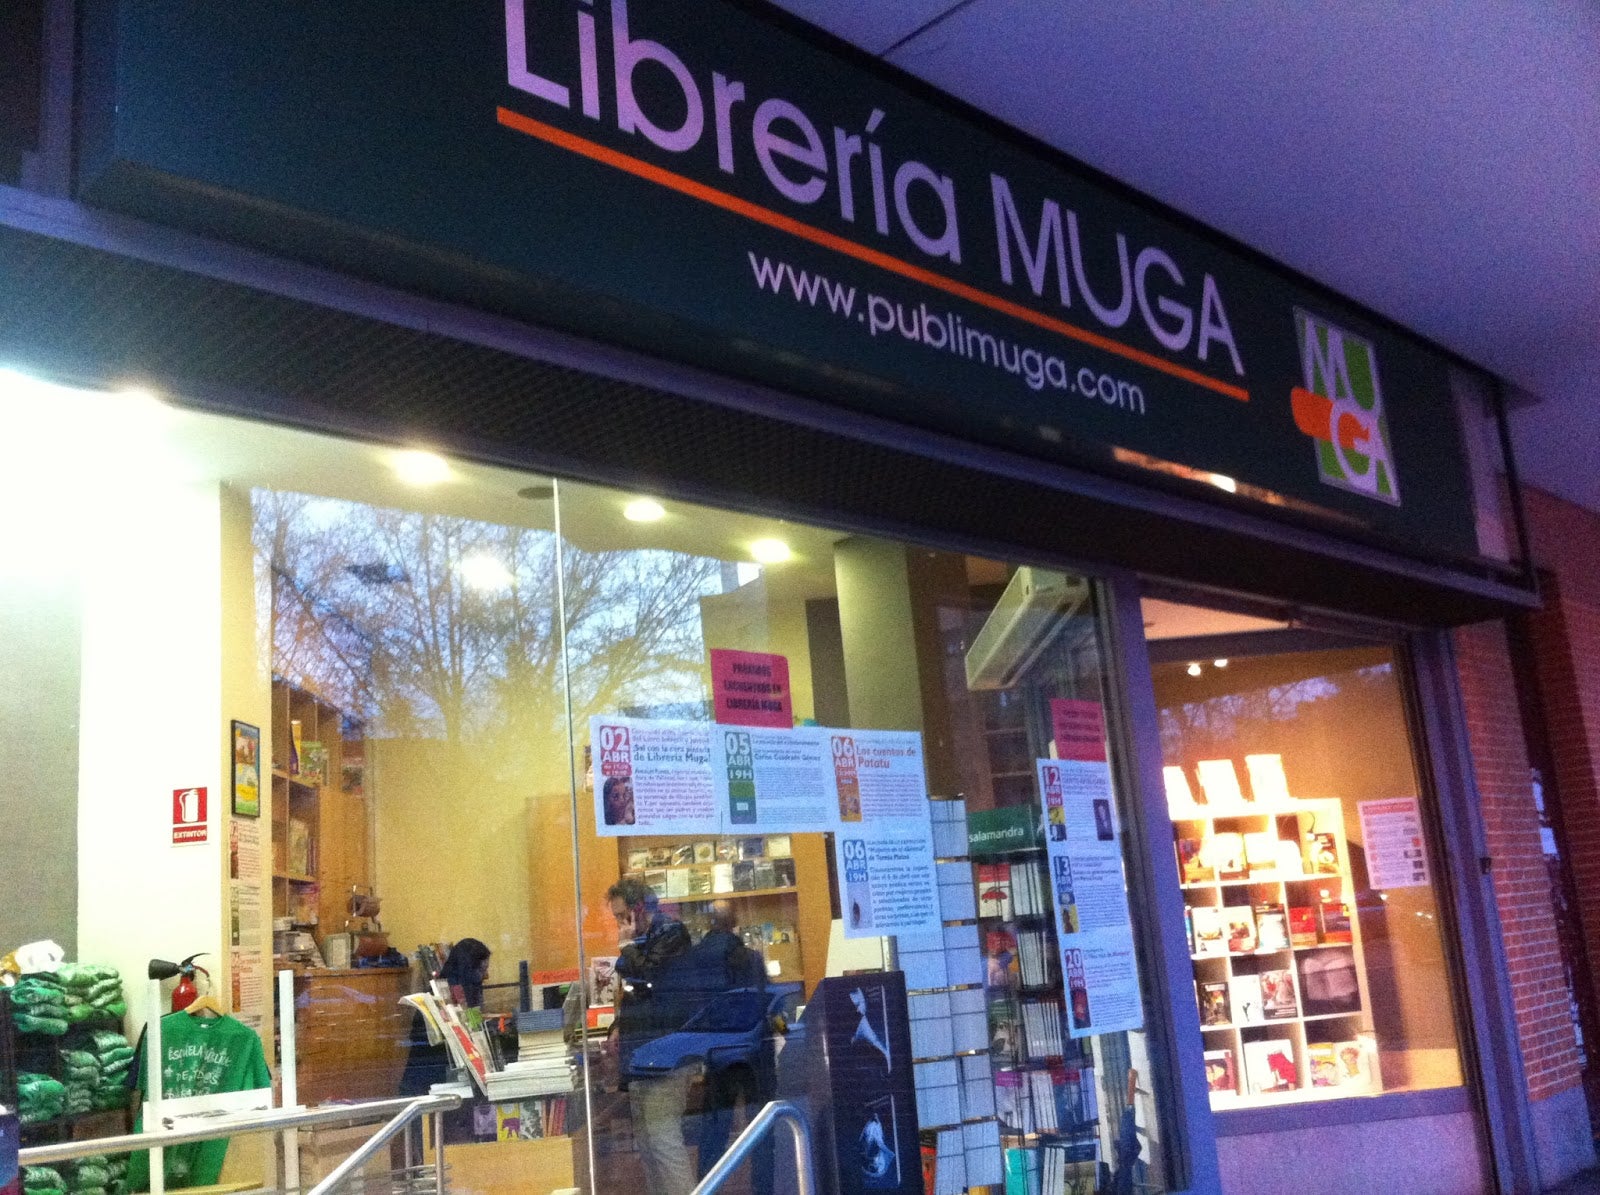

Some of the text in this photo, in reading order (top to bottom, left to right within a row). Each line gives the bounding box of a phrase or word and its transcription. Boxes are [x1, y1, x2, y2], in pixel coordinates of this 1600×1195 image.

[504, 0, 1245, 376] Librería MUGA
[748, 250, 1145, 415] www.publimuga.com
[600, 727, 629, 751] 02
[726, 732, 751, 755] 05
[832, 738, 855, 758] 06
[856, 745, 917, 757] Los cuentos de
[602, 751, 629, 763] ABR
[634, 753, 643, 761] de
[728, 755, 752, 766] ABR
[835, 757, 856, 768] ABR
[729, 769, 753, 779] 19H
[1043, 768, 1060, 786] 12
[173, 829, 207, 840] EXTINTOR
[968, 826, 1024, 843] salamandra
[844, 841, 865, 859] 06
[846, 859, 867, 870] ABR
[1055, 857, 1070, 876] 13
[849, 871, 868, 882] 19H
[1065, 950, 1082, 968] 20
